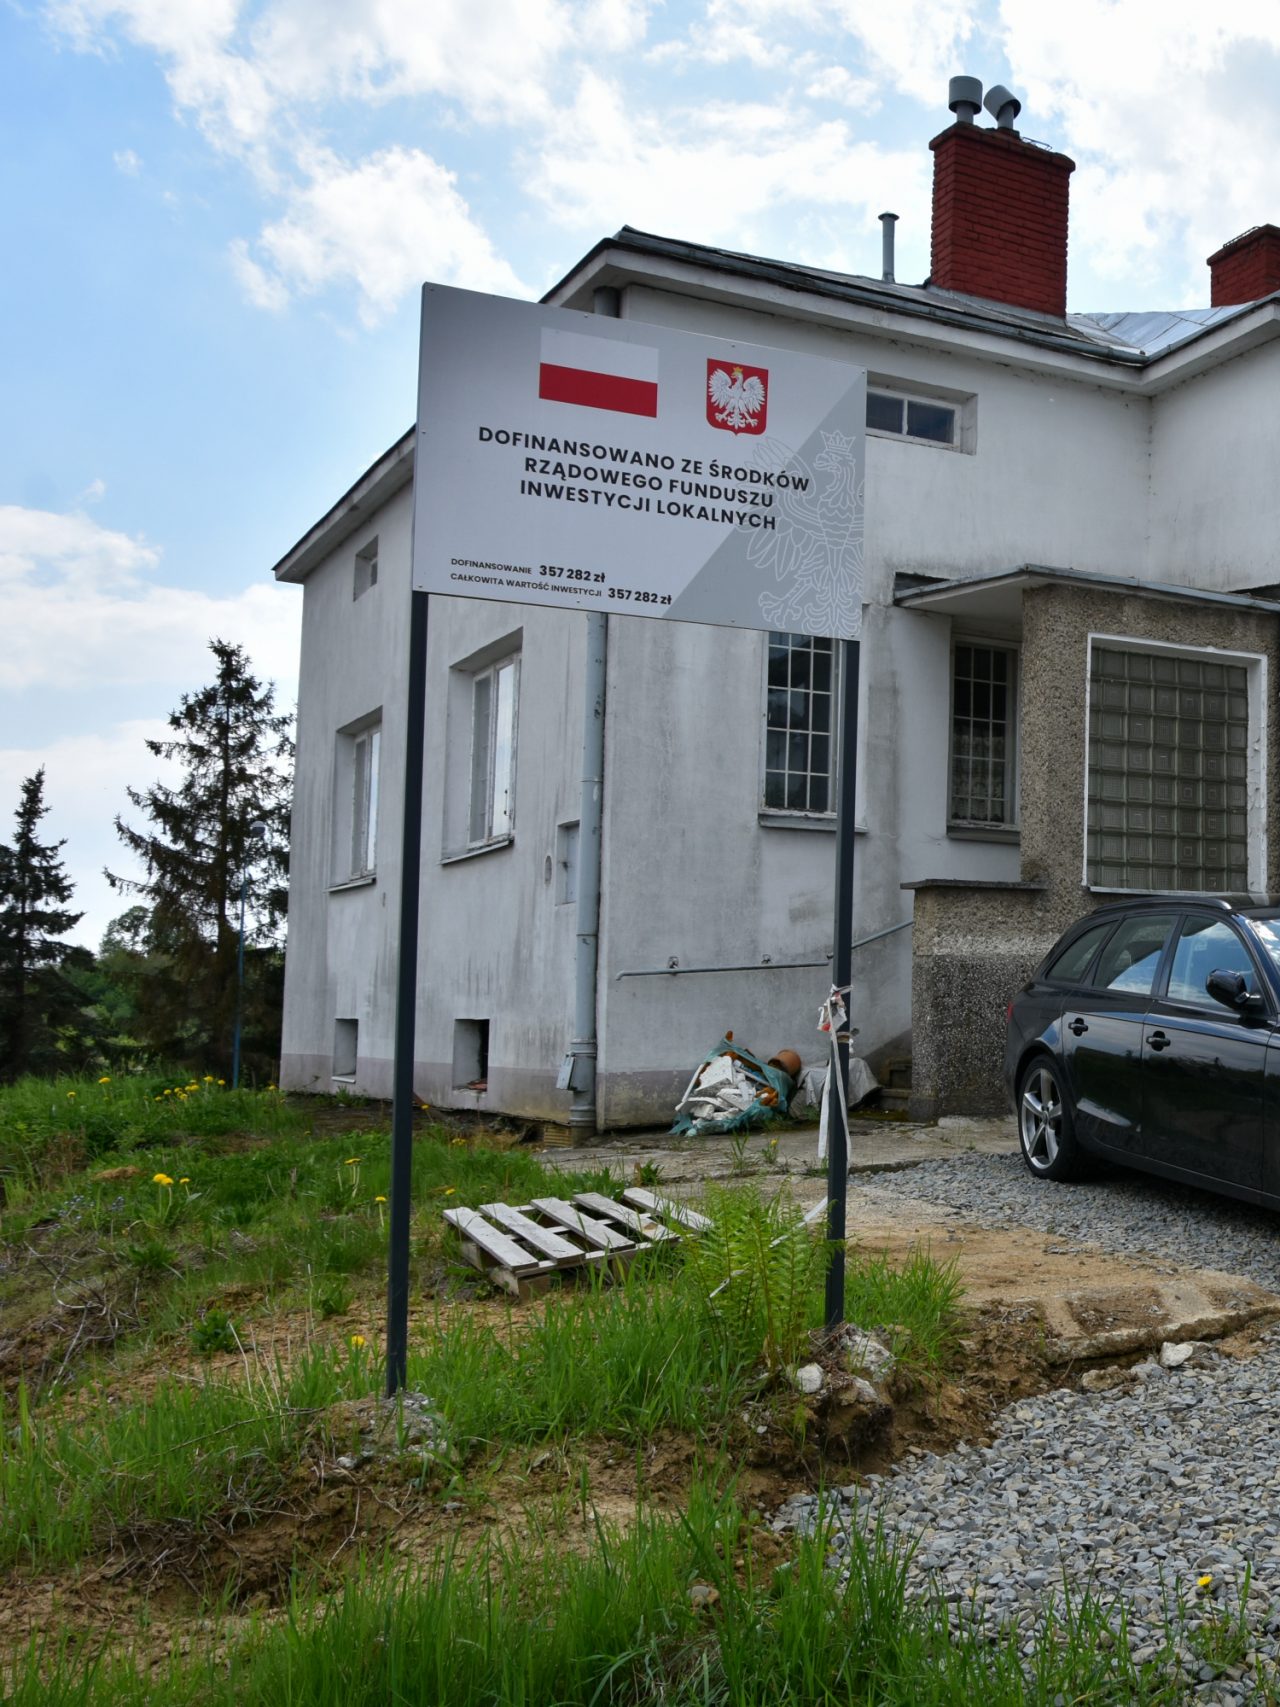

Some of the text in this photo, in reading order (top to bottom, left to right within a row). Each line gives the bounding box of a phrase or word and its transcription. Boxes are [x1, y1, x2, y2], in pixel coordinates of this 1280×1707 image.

[479, 427, 809, 491] DOFINANSOWANO ZE ŚRODKÓW
[525, 457, 773, 507] RZĄDOWEGO FUNDUSZU
[520, 480, 776, 530] INWESTYCJI LOKALNYCH
[450, 573, 672, 605] CAŁKOWITA WARTOŚĆ INWESTYCJI 357 282 zł
[451, 558, 606, 583] DOFINANSOWANIE 357 282 zł
